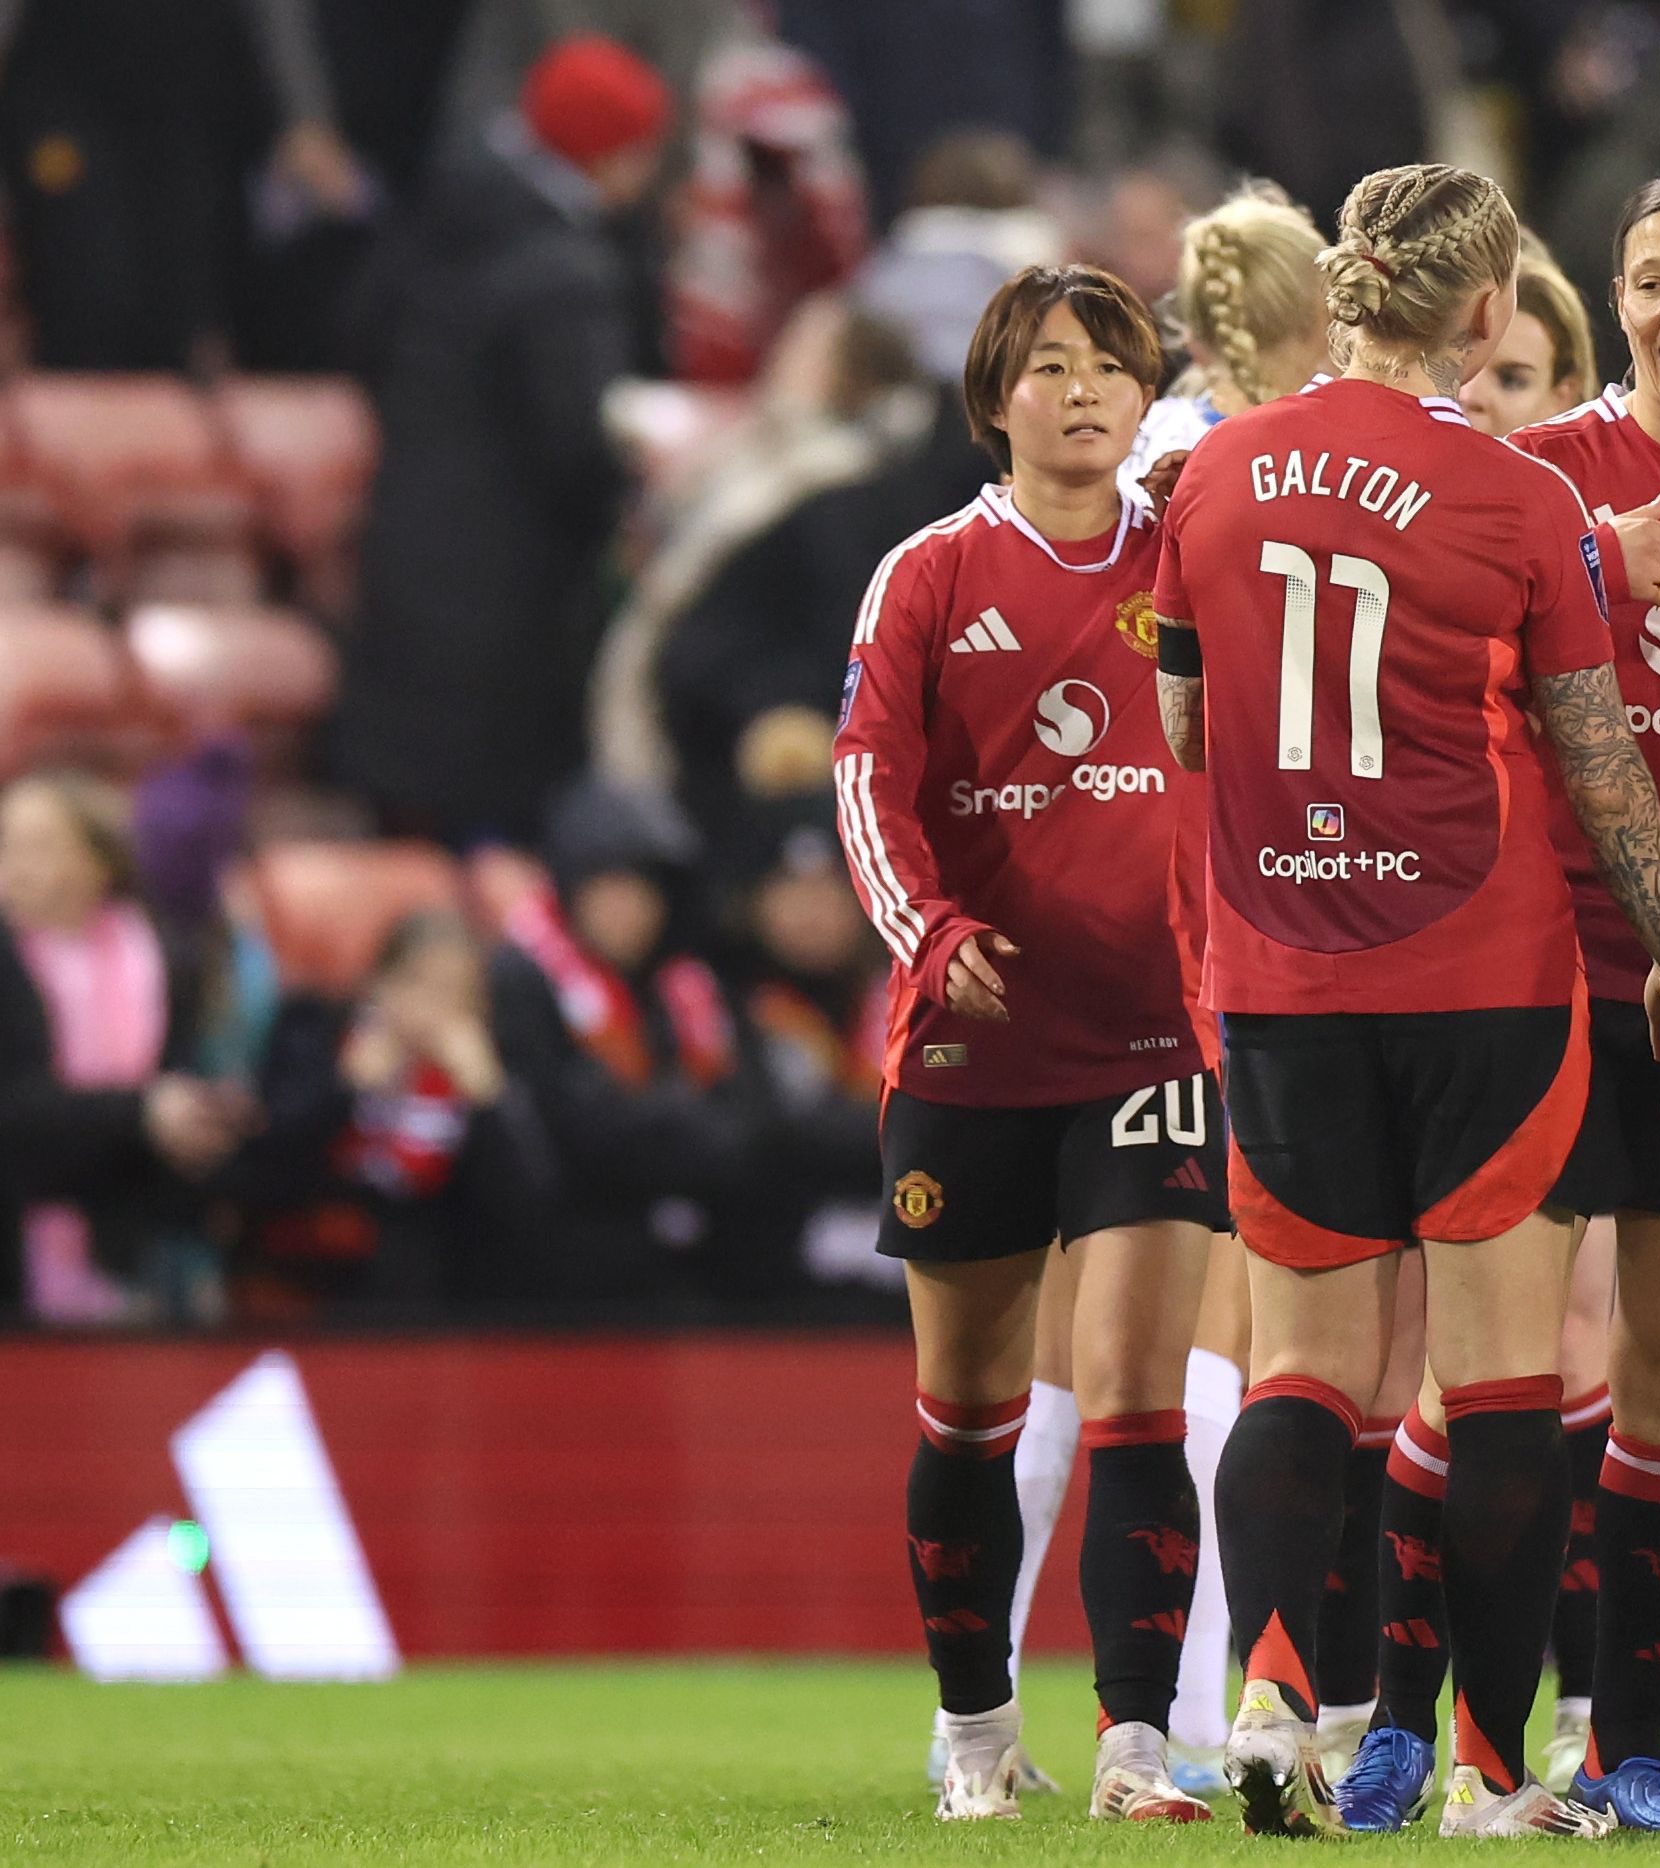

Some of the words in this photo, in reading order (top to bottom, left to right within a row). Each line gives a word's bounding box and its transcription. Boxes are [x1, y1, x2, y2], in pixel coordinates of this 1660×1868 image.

[1250, 449, 1432, 531] GALTON
[1259, 540, 1390, 779] 11
[1111, 1072, 1206, 1148] 20
